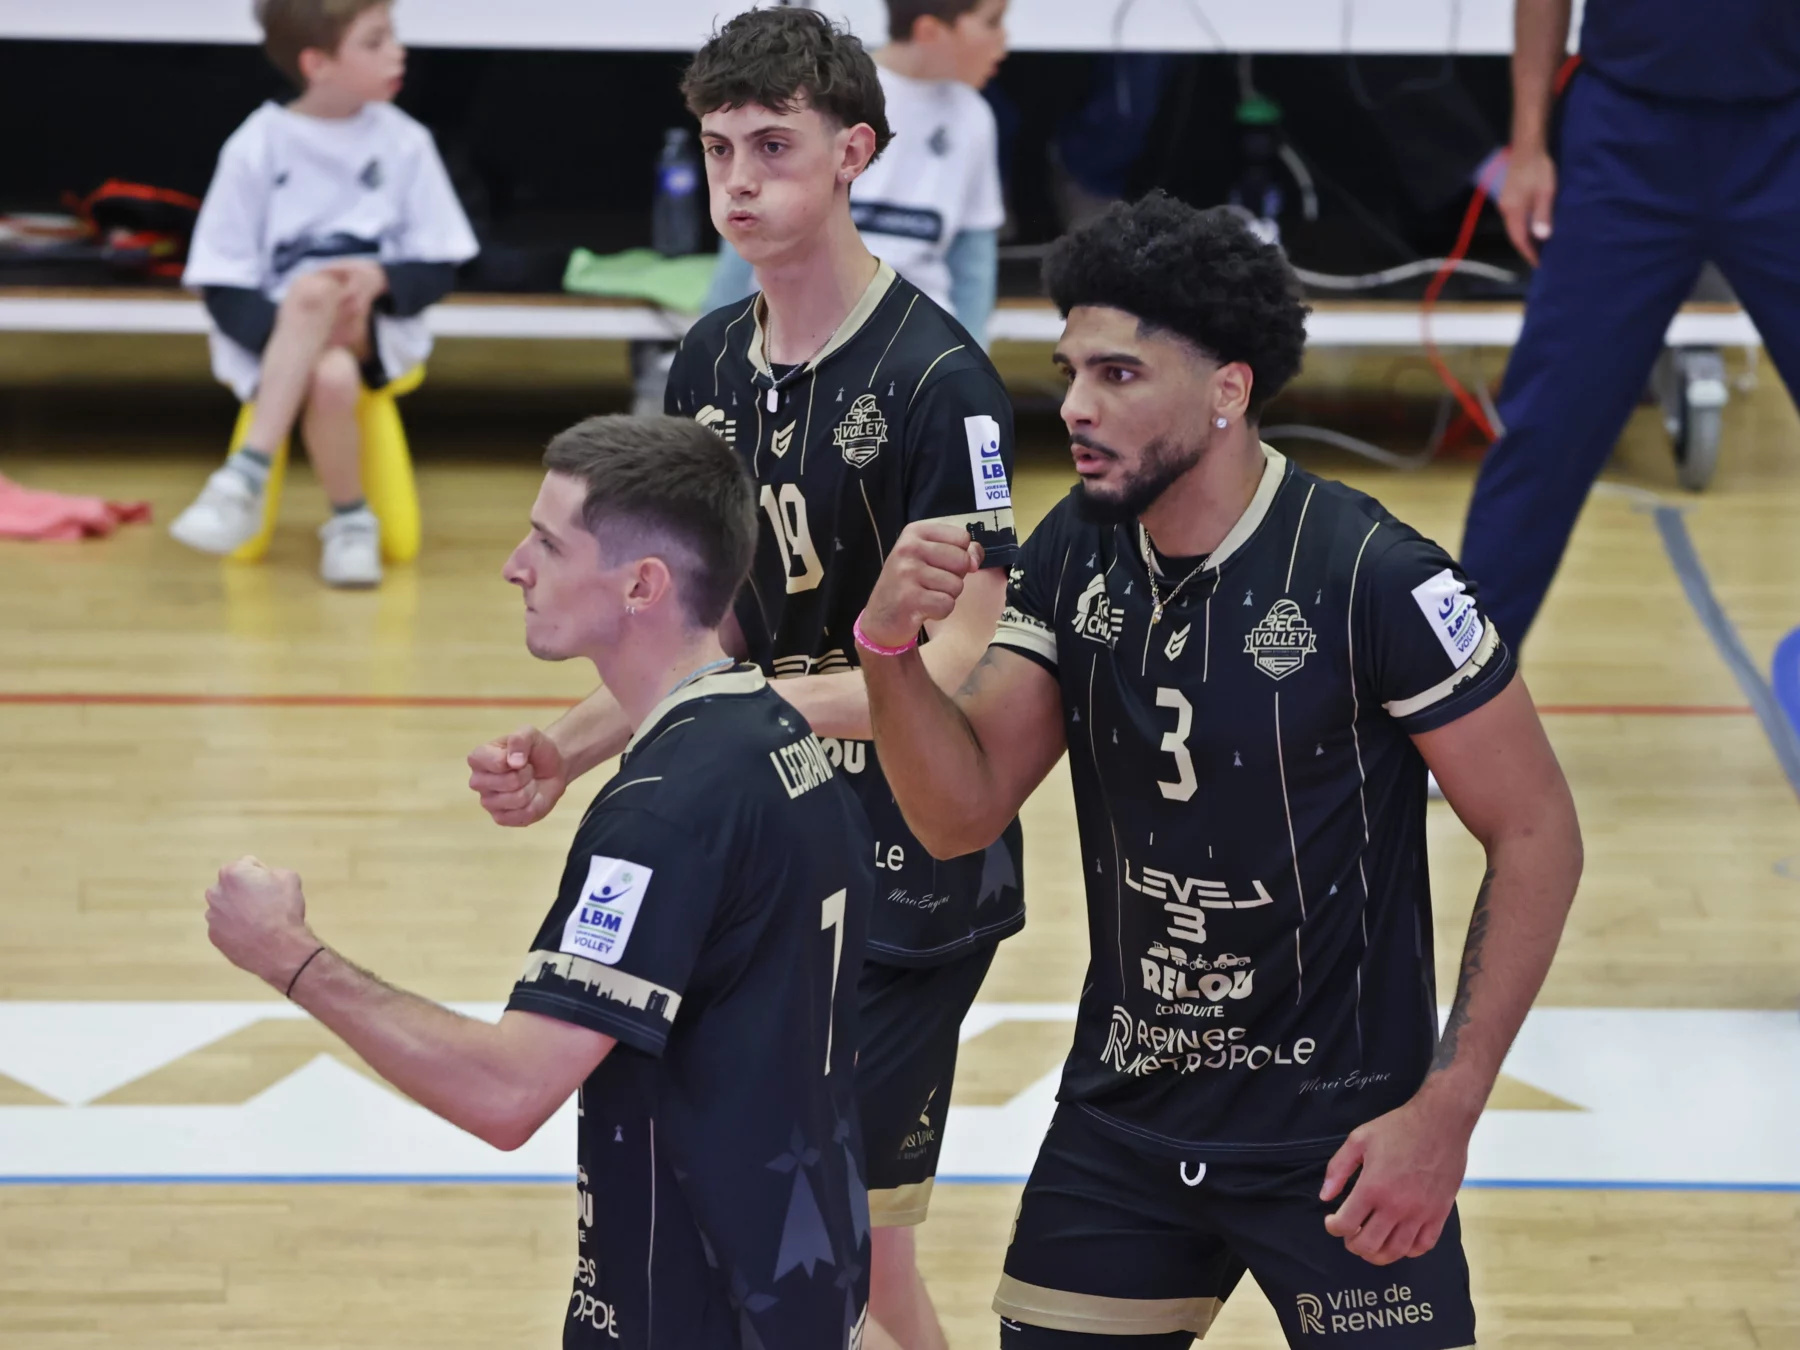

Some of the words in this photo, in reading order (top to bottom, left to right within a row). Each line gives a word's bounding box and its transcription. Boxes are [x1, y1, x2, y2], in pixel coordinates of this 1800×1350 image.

[982, 463, 1004, 479] LB
[986, 489, 1010, 500] VOLL
[760, 484, 825, 594] 19
[1267, 614, 1299, 631] REC
[1254, 631, 1308, 646] VOLLEY
[1156, 687, 1198, 802] 3
[769, 731, 834, 799] LEGRAN
[1125, 858, 1274, 909] LEVEL
[580, 907, 622, 932] LBM
[1163, 901, 1207, 944] 3
[574, 936, 612, 954] VOLLEY
[1140, 957, 1256, 1002] RELOU
[1155, 1003, 1225, 1018] CONDUITE
[1299, 1076, 1341, 1095] Merci
[1327, 1288, 1378, 1310] Ville
[1384, 1283, 1411, 1303] de
